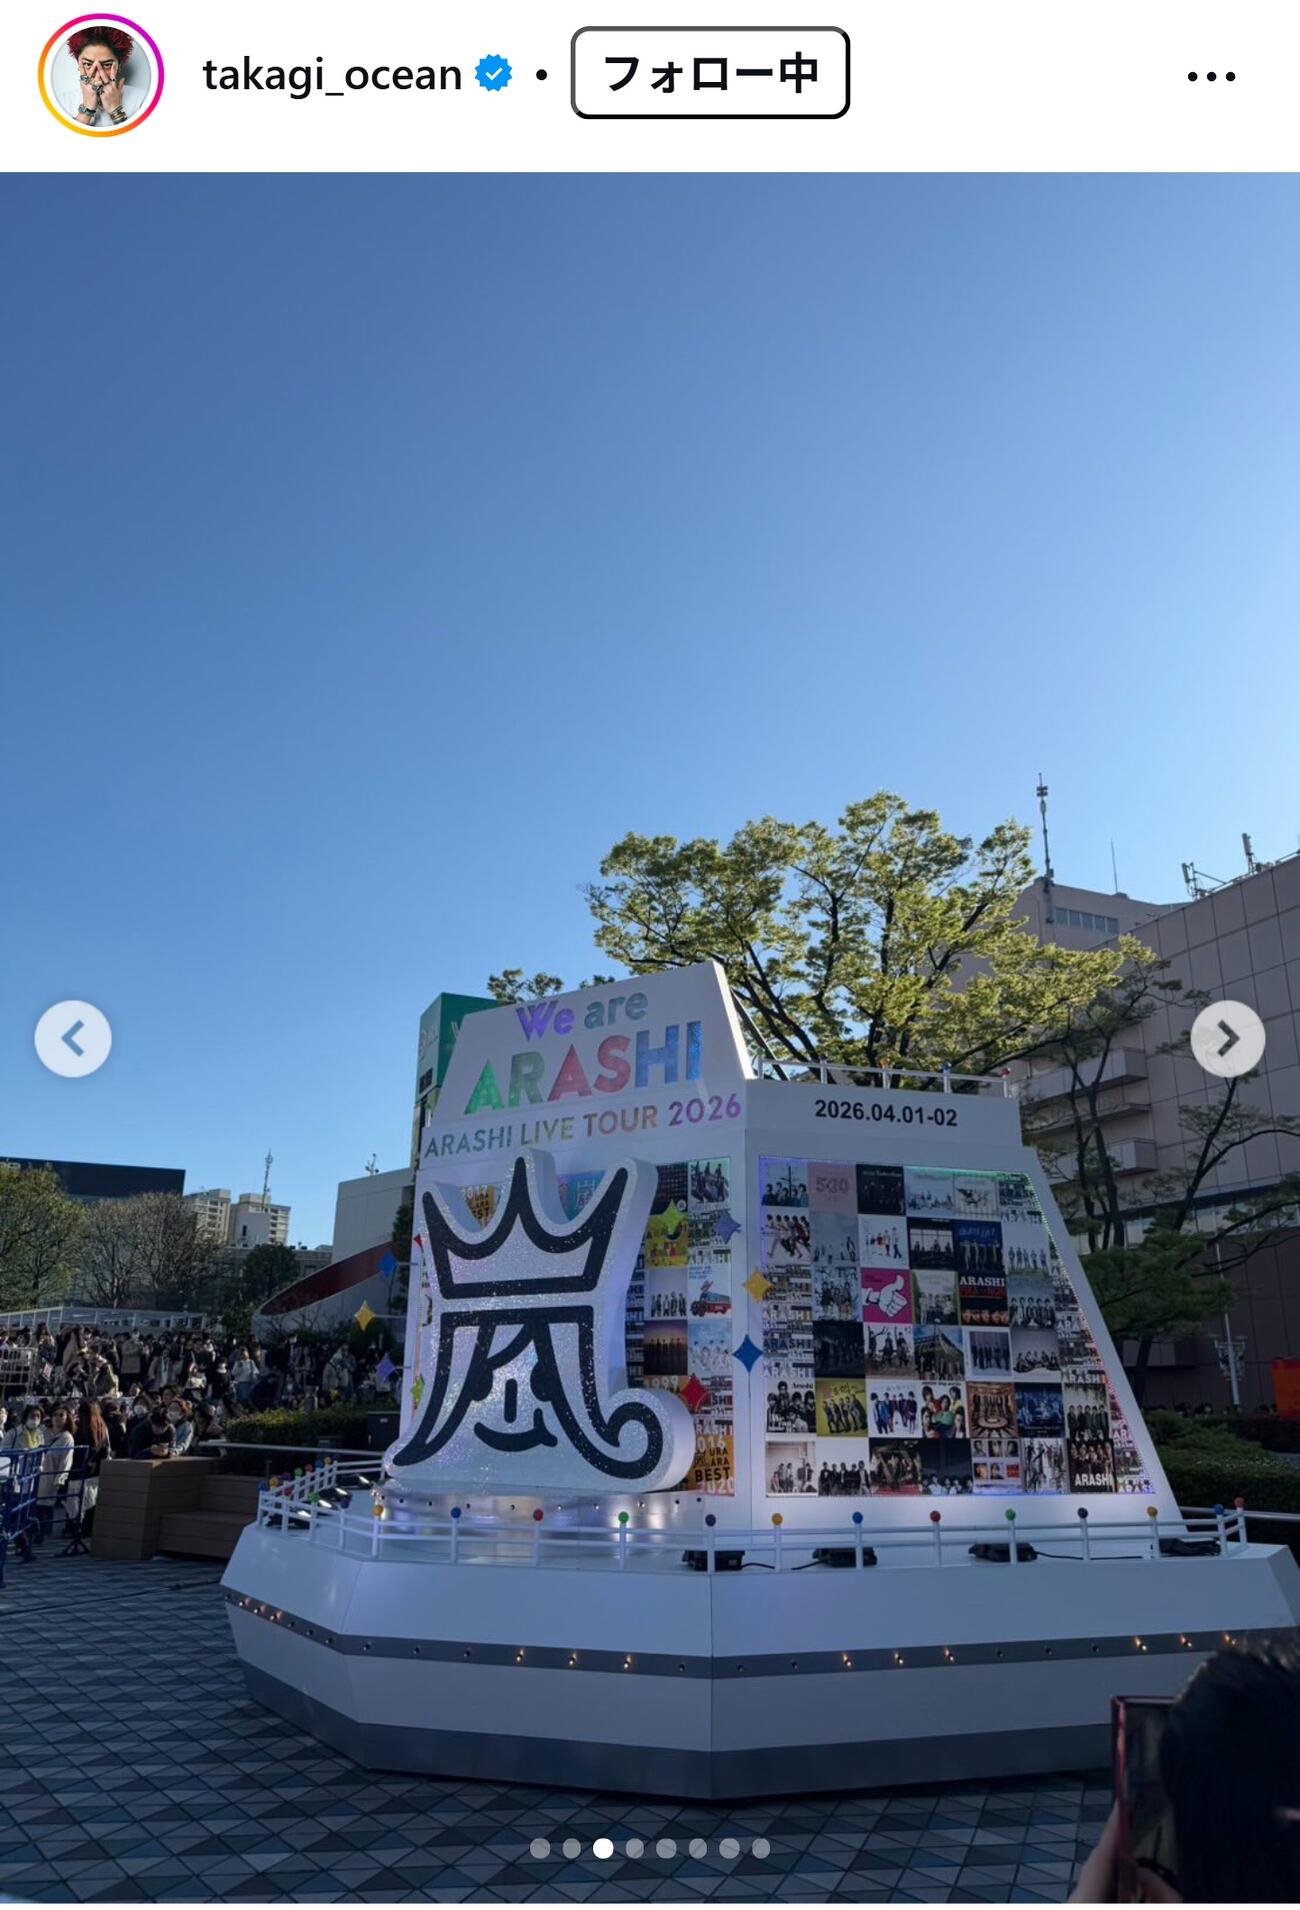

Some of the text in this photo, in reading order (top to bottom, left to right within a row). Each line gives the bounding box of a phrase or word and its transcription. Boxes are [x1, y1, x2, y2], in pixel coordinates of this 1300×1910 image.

[516, 992, 648, 1041] We are
[464, 1021, 702, 1114] ARASHI
[424, 1093, 741, 1158] ARASHI LIVE TOUR 2026
[815, 1099, 958, 1127] 2026.04.01-02
[959, 1276, 1006, 1288] ARASHI
[694, 1466, 730, 1482] BEST
[1074, 1473, 1114, 1487] ARASHI
